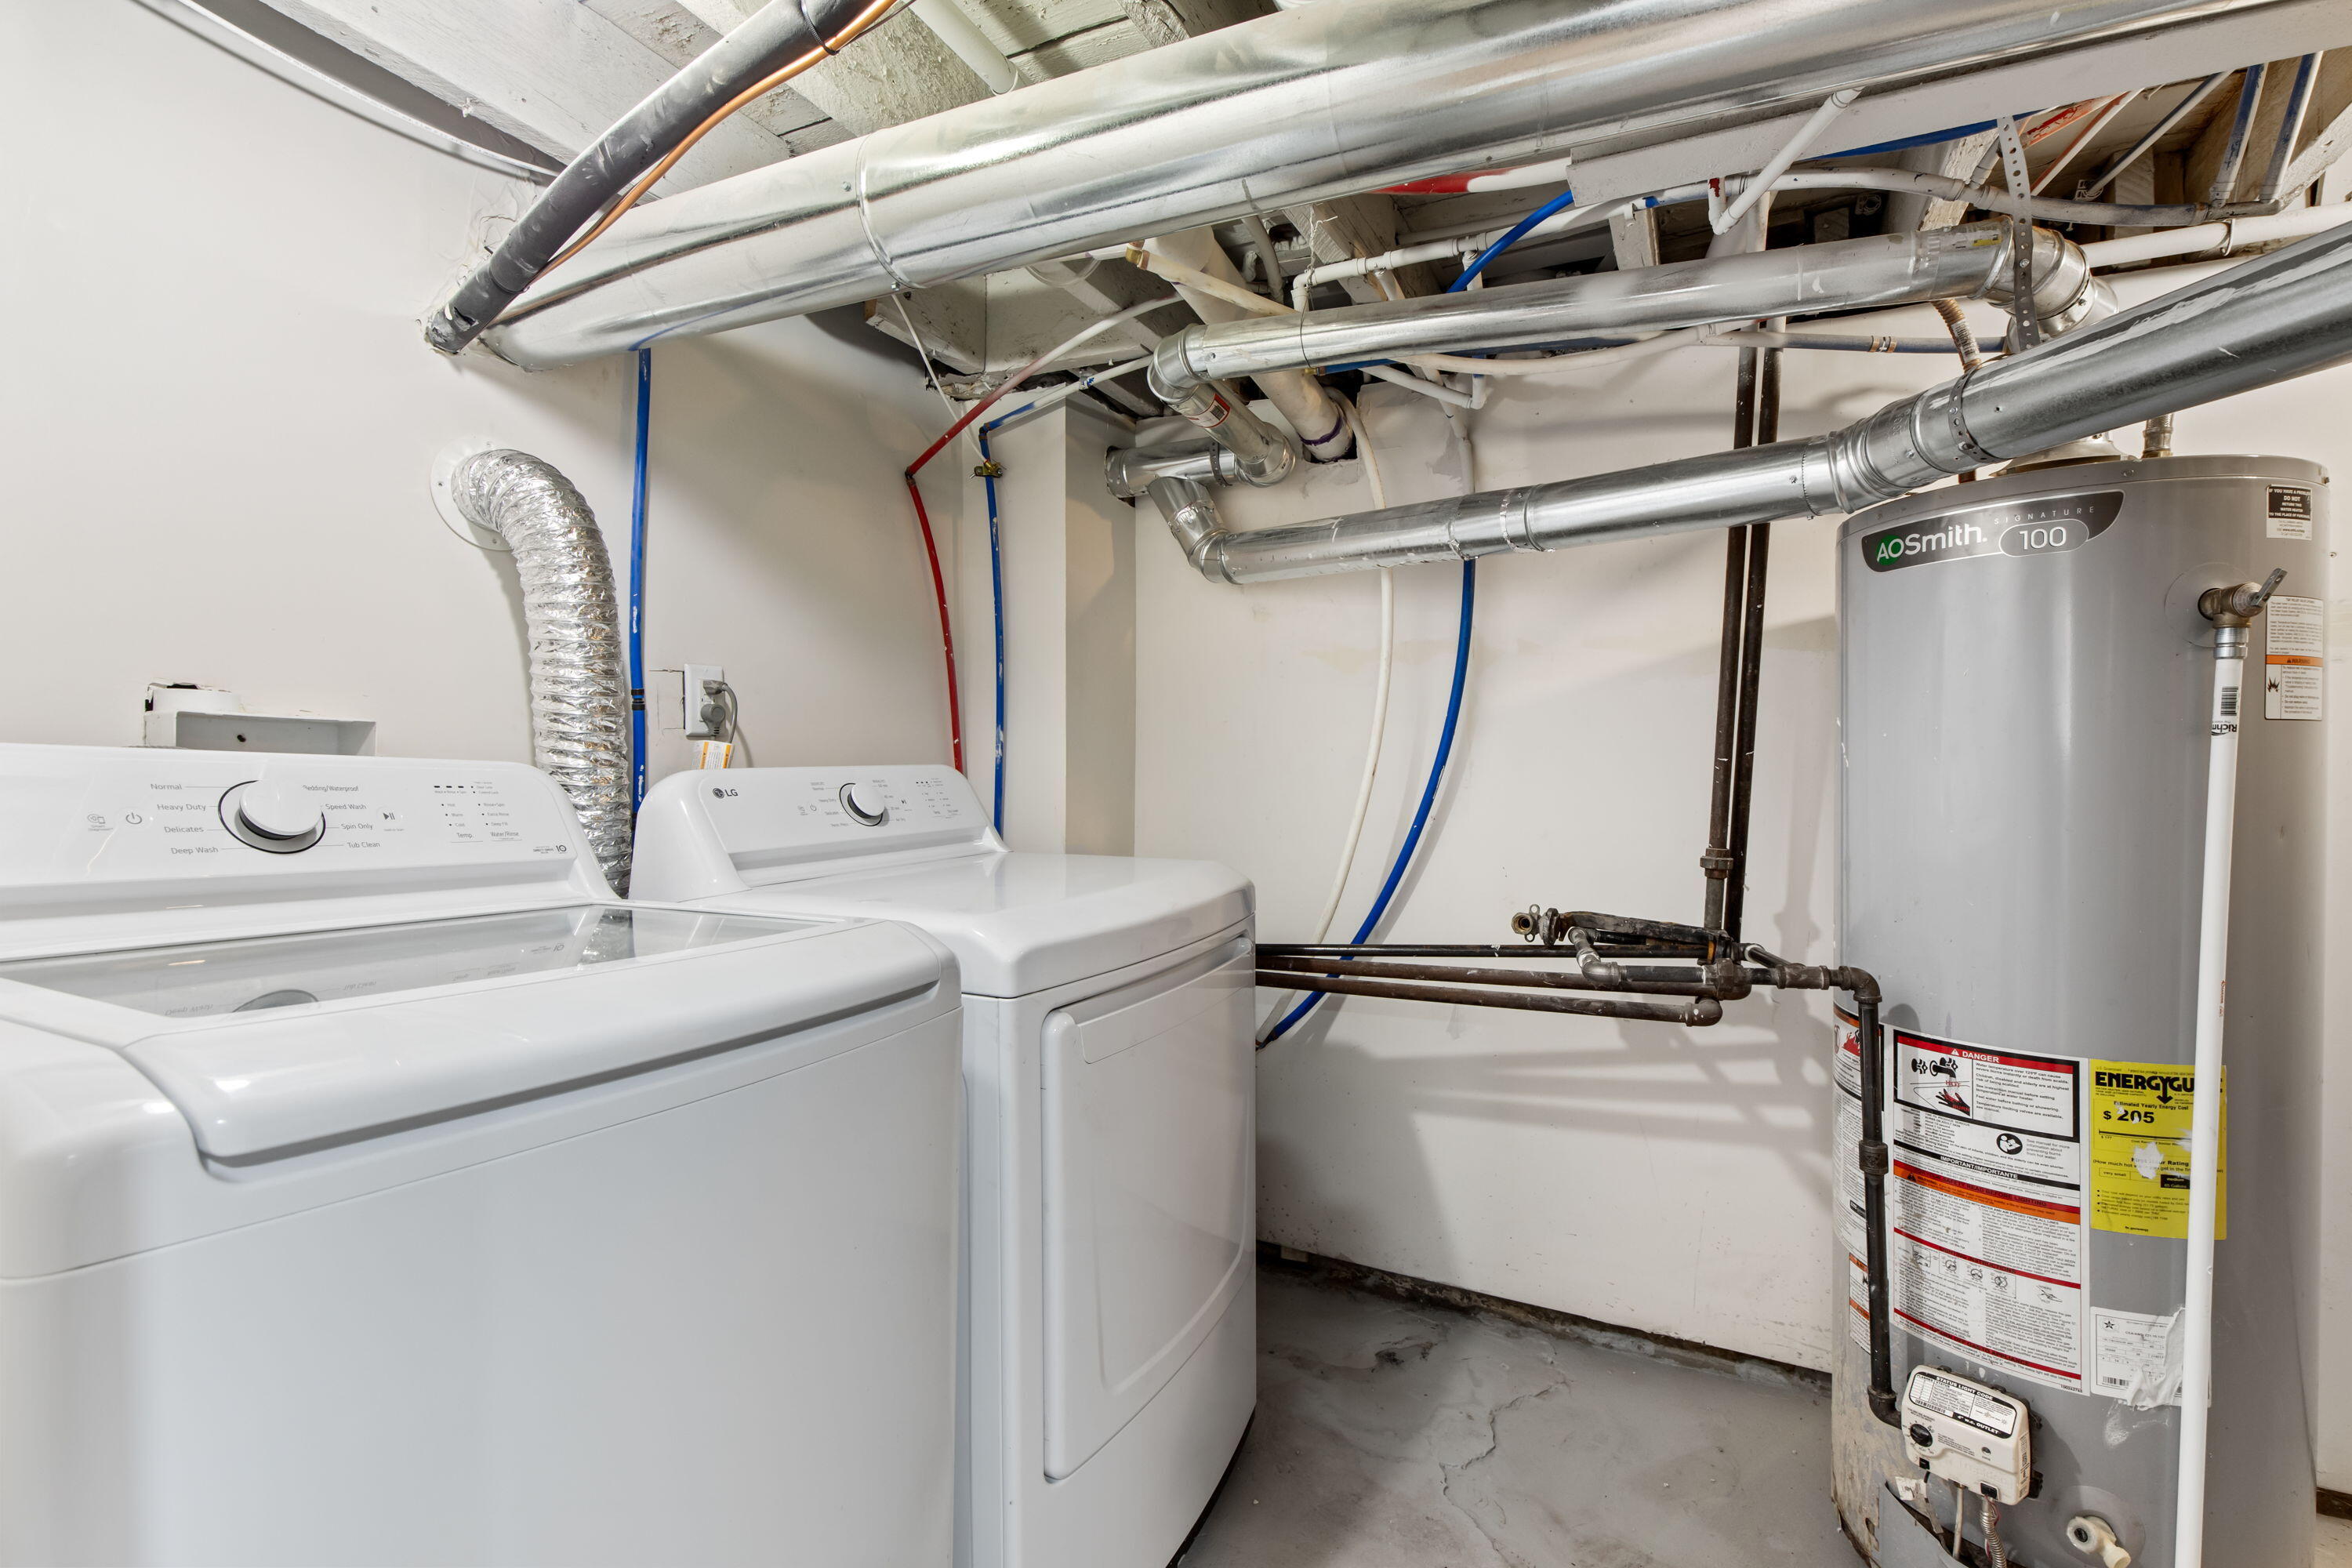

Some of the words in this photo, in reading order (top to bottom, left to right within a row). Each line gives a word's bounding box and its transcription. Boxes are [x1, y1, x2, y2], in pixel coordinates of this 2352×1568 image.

[1994, 506, 2095, 524] SIGNATURE
[2019, 526, 2067, 550] 100
[1962, 1051, 1999, 1063] DANGER
[2103, 1110, 2112, 1120] $
[2117, 1110, 2154, 1123] 205
[1940, 1155, 2018, 1180] IMPORTANT/IMPORTANTE
[1936, 1376, 1958, 1387] STATUS
[1958, 1383, 1976, 1395] LIGHT
[1976, 1391, 1993, 1401] CODE
[1976, 1422, 1999, 1435] OUTLET
